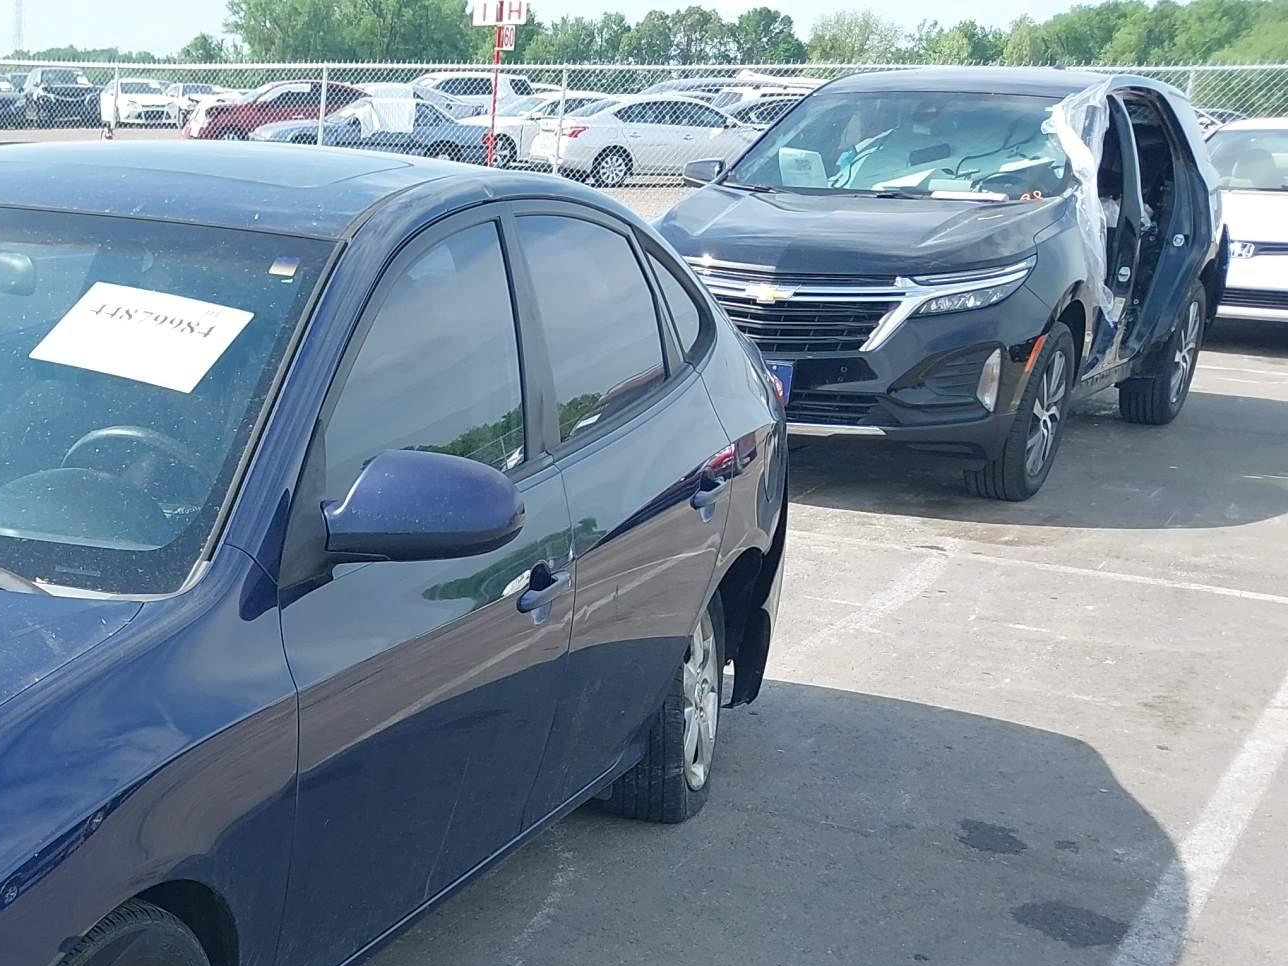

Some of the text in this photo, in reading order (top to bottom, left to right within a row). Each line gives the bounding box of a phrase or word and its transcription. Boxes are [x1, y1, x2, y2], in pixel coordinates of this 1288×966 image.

[508, 1, 522, 20] H
[504, 26, 515, 47] 60
[89, 303, 216, 339] 44879984
